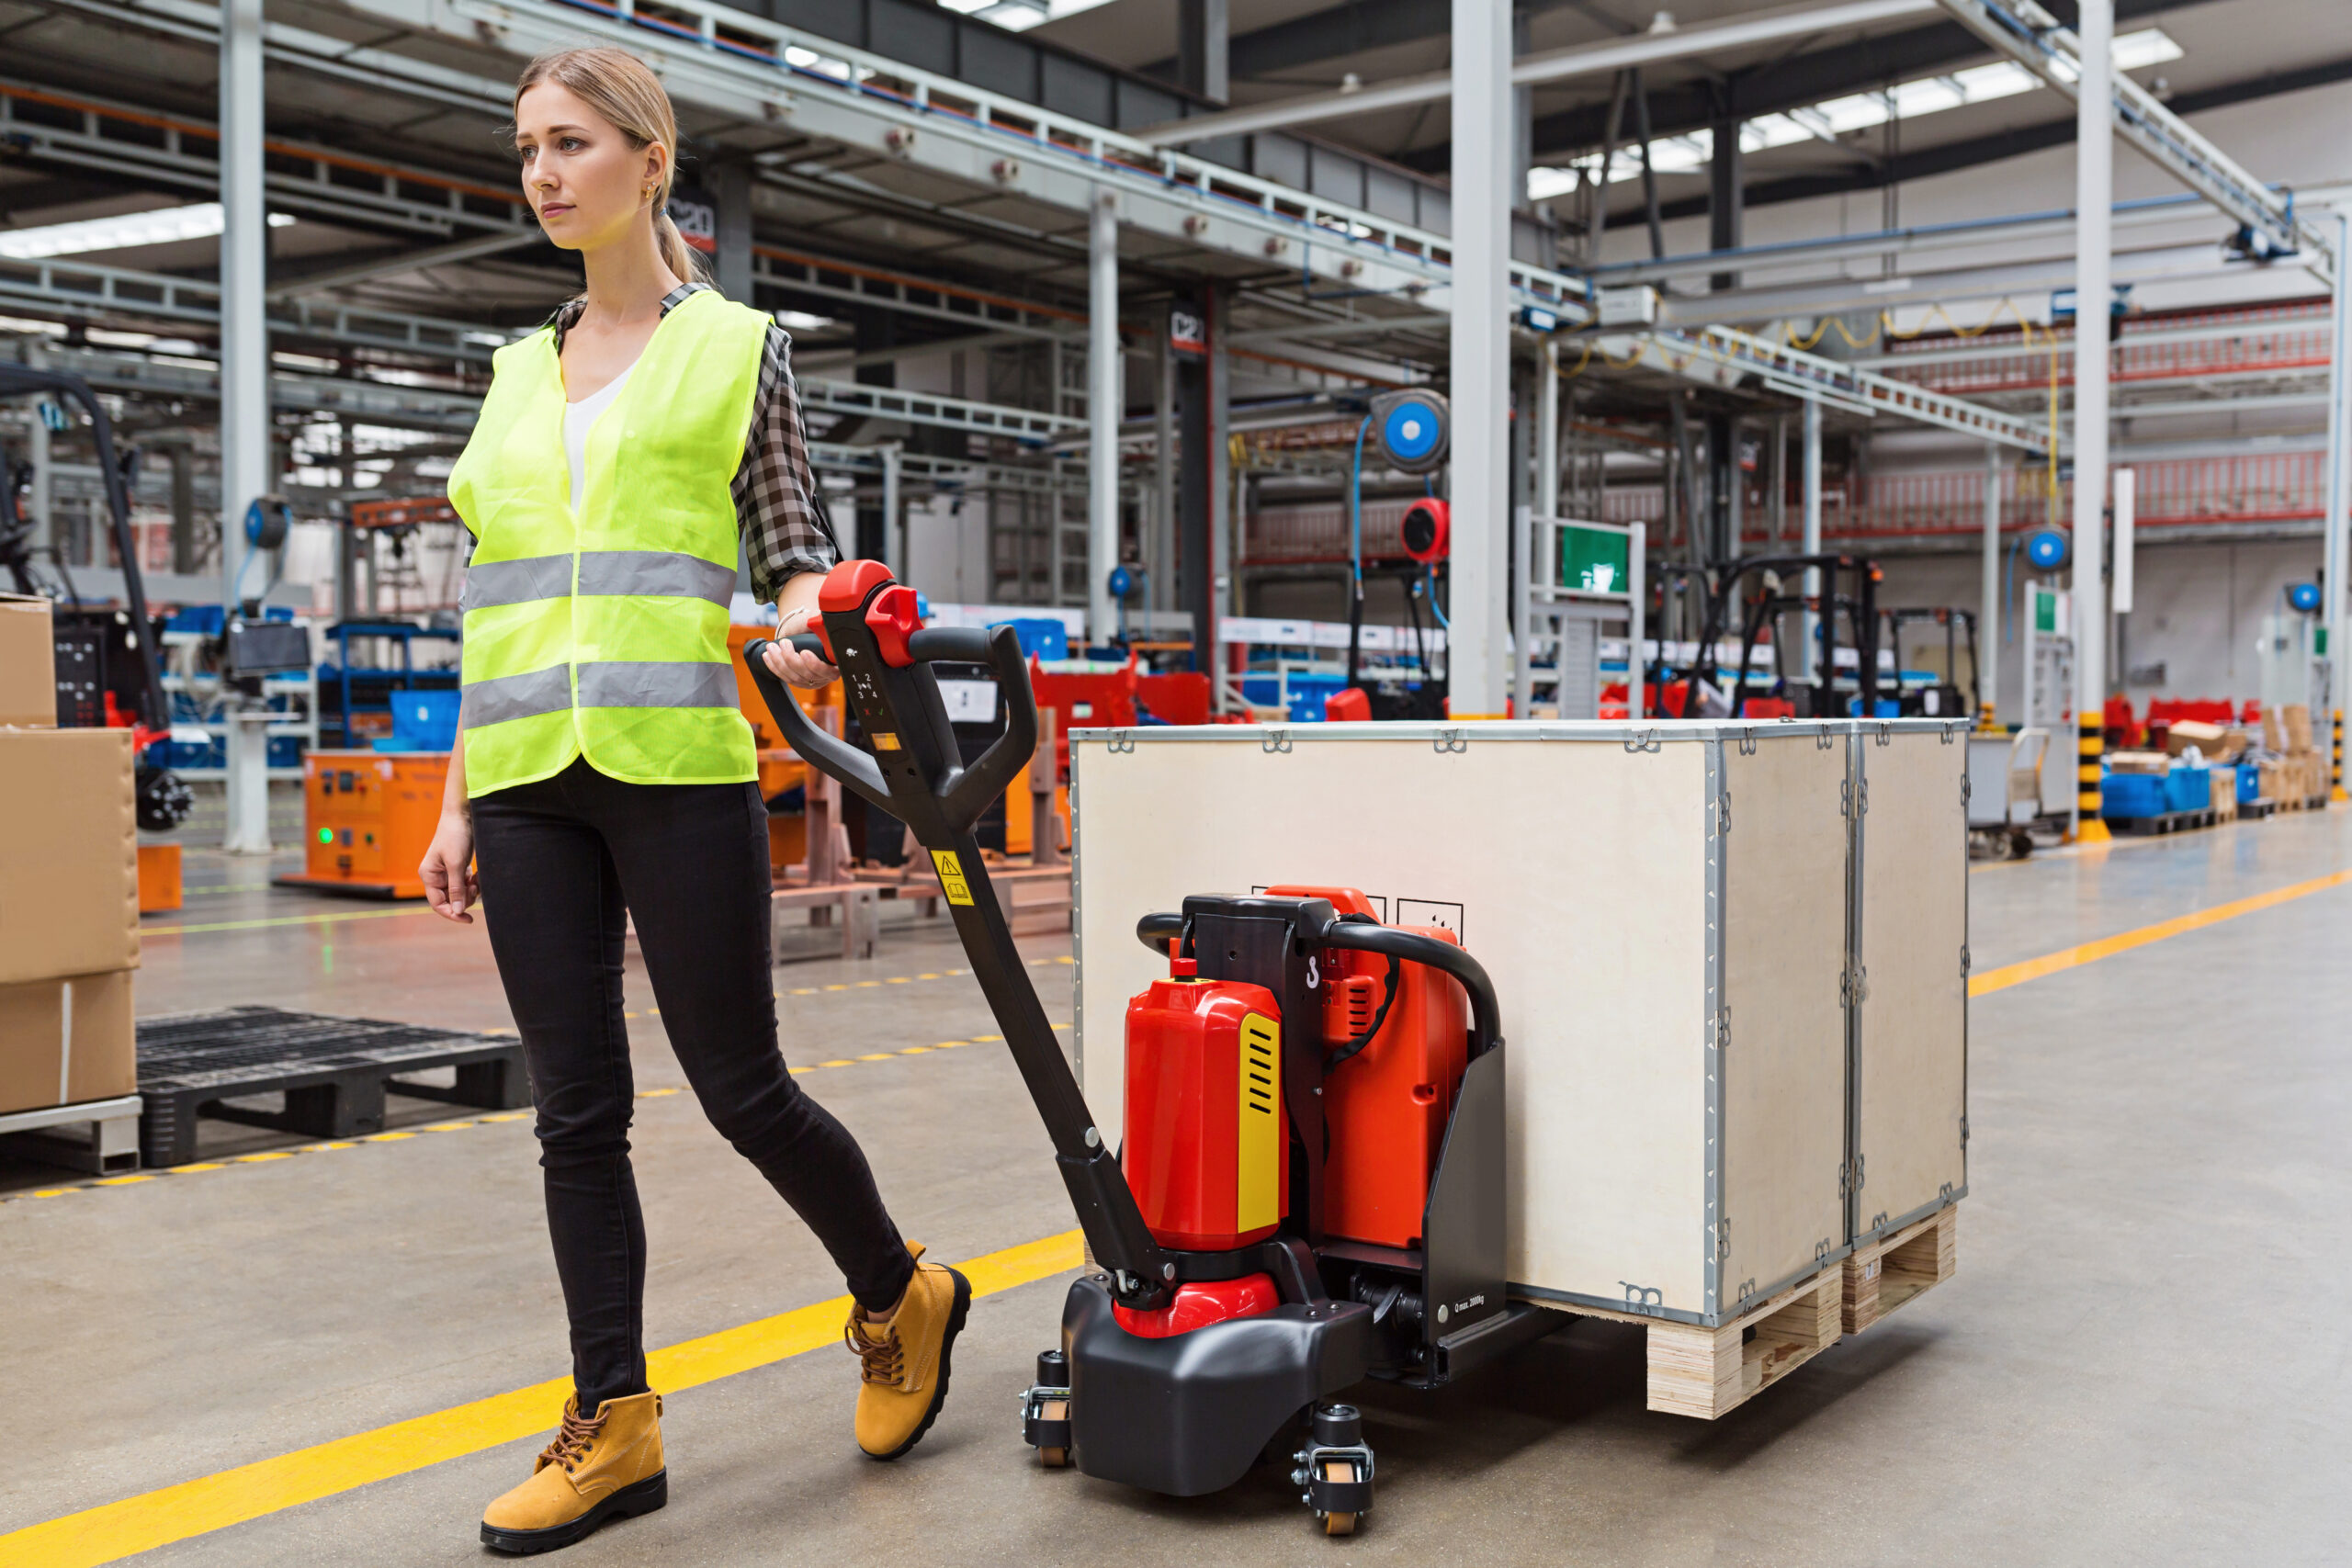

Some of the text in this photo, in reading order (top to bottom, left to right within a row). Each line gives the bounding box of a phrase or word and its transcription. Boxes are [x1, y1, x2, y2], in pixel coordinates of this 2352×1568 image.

[865, 673, 871, 682] 2
[858, 691, 864, 699] 3
[1454, 1294, 1485, 1313] Q max. 2000kg
